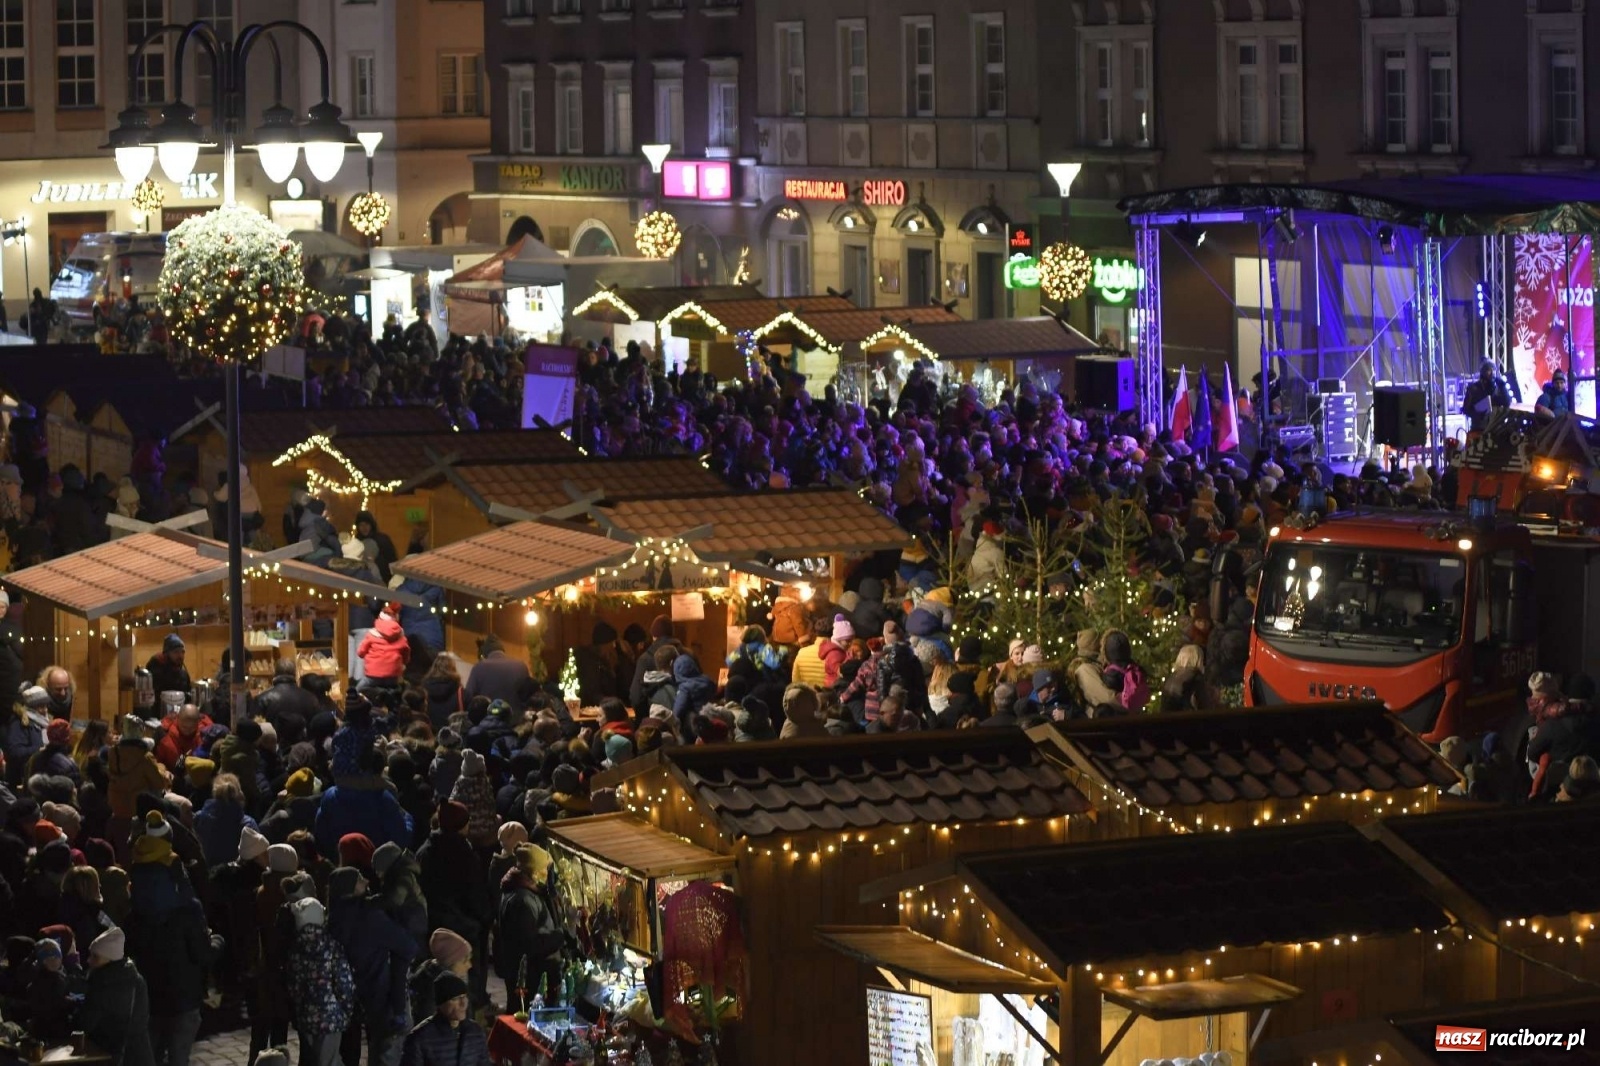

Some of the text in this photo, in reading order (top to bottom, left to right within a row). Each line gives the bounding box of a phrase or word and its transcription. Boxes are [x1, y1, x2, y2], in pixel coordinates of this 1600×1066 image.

[560, 165, 627, 190] KANTOR
[785, 179, 905, 206] RESTAURACJA SHIRO
[598, 576, 725, 591] KONIEC ŚWIATA
[1308, 681, 1377, 702] IVECO
